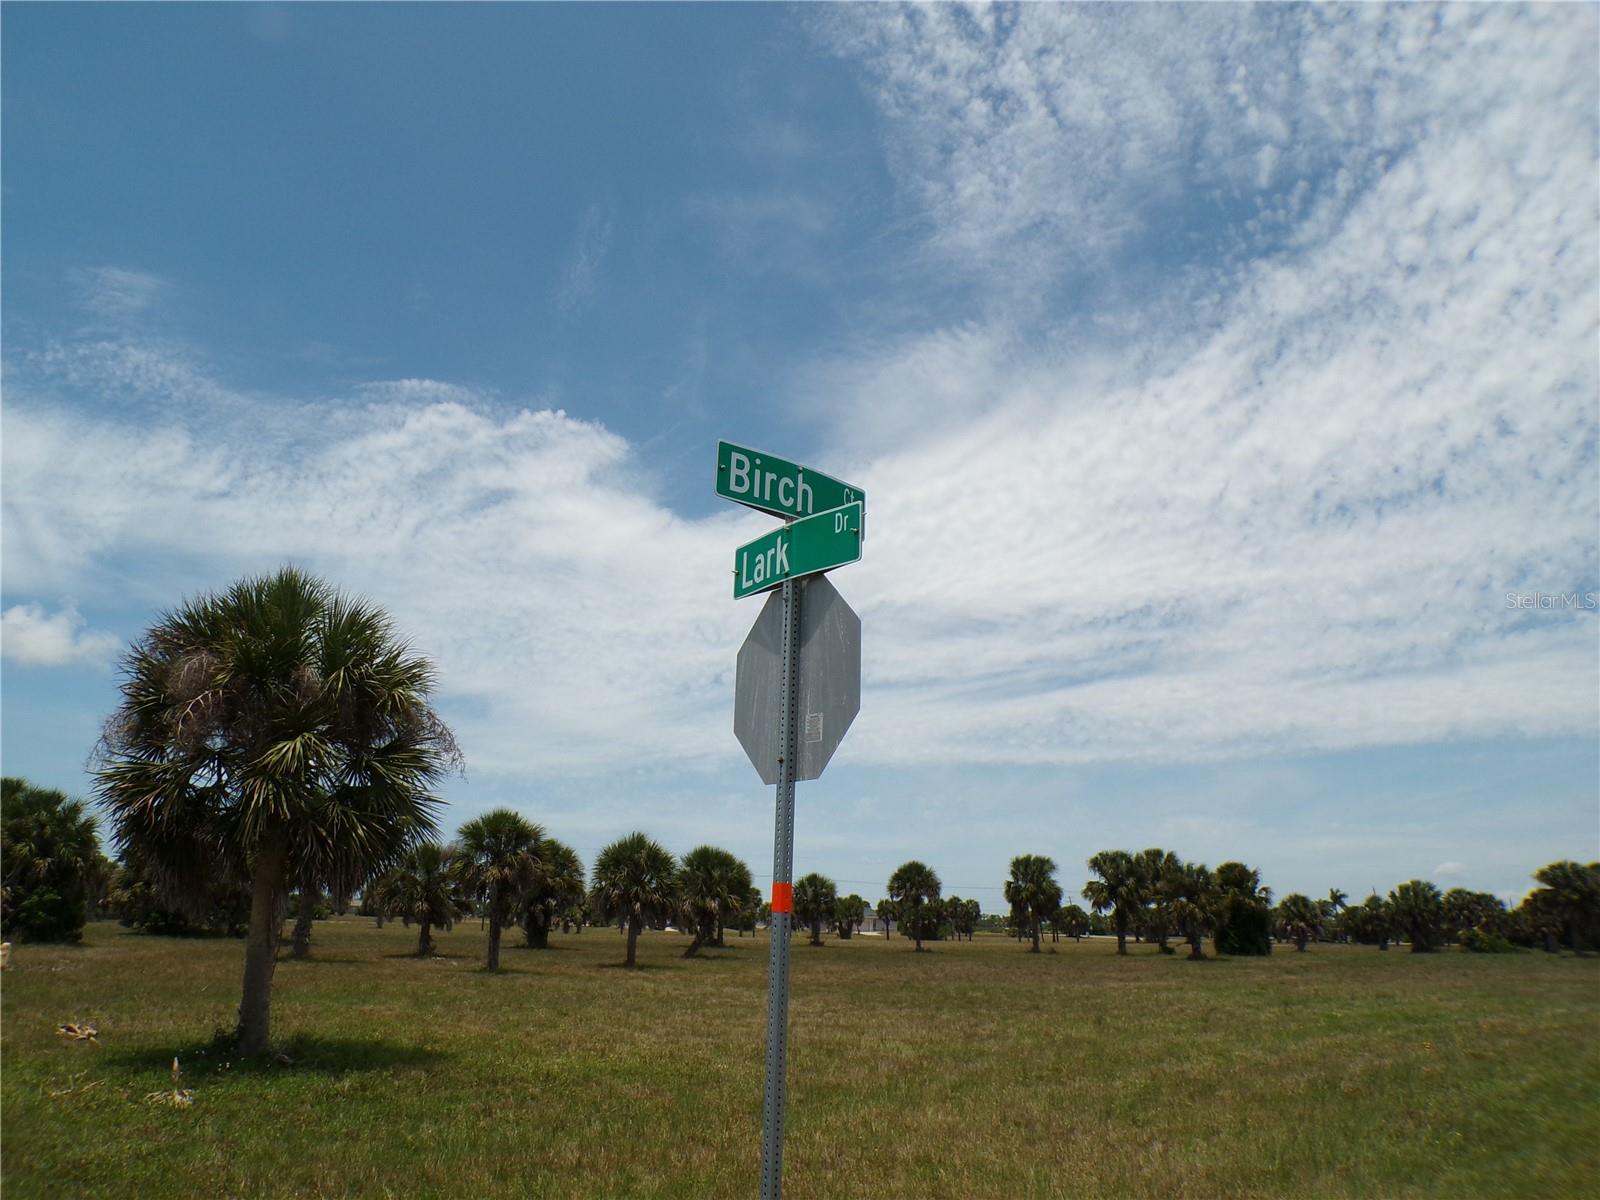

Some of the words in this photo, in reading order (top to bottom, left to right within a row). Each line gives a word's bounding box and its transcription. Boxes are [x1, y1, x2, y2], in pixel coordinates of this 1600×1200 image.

[729, 451, 813, 514] Birch
[843, 488, 855, 505] Ct
[742, 535, 790, 589] Lark
[834, 512, 848, 533] Dr
